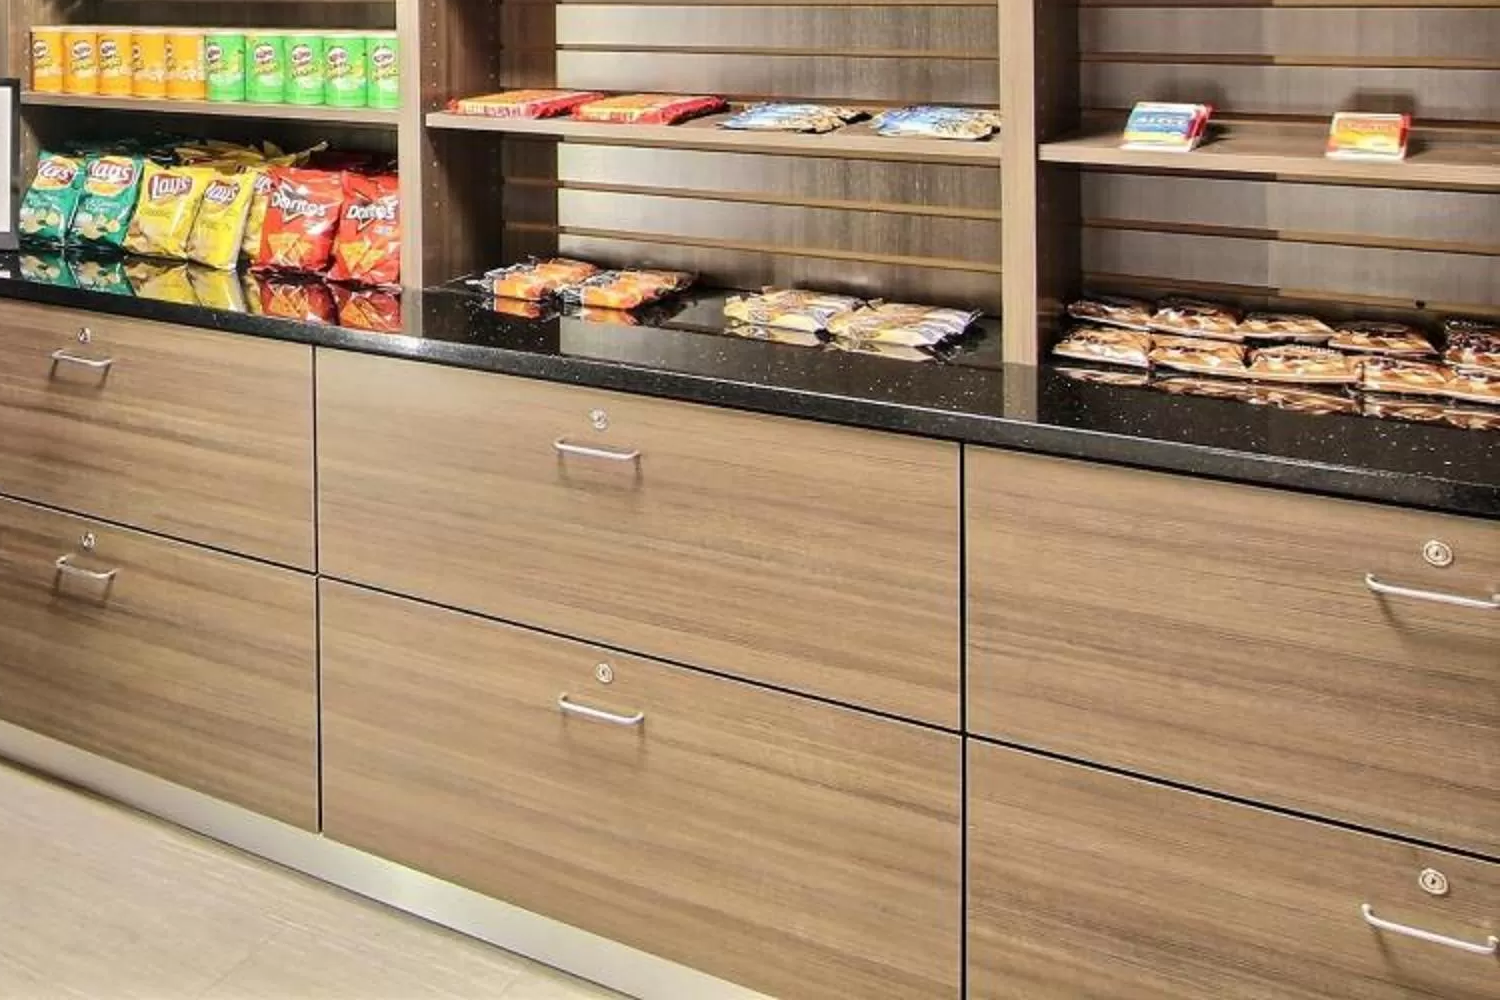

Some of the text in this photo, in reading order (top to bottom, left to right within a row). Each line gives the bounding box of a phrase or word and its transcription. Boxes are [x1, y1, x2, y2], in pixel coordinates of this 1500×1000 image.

[153, 174, 191, 200] Lay's
[271, 191, 327, 217] Doritos
[346, 200, 397, 221] Doritos
